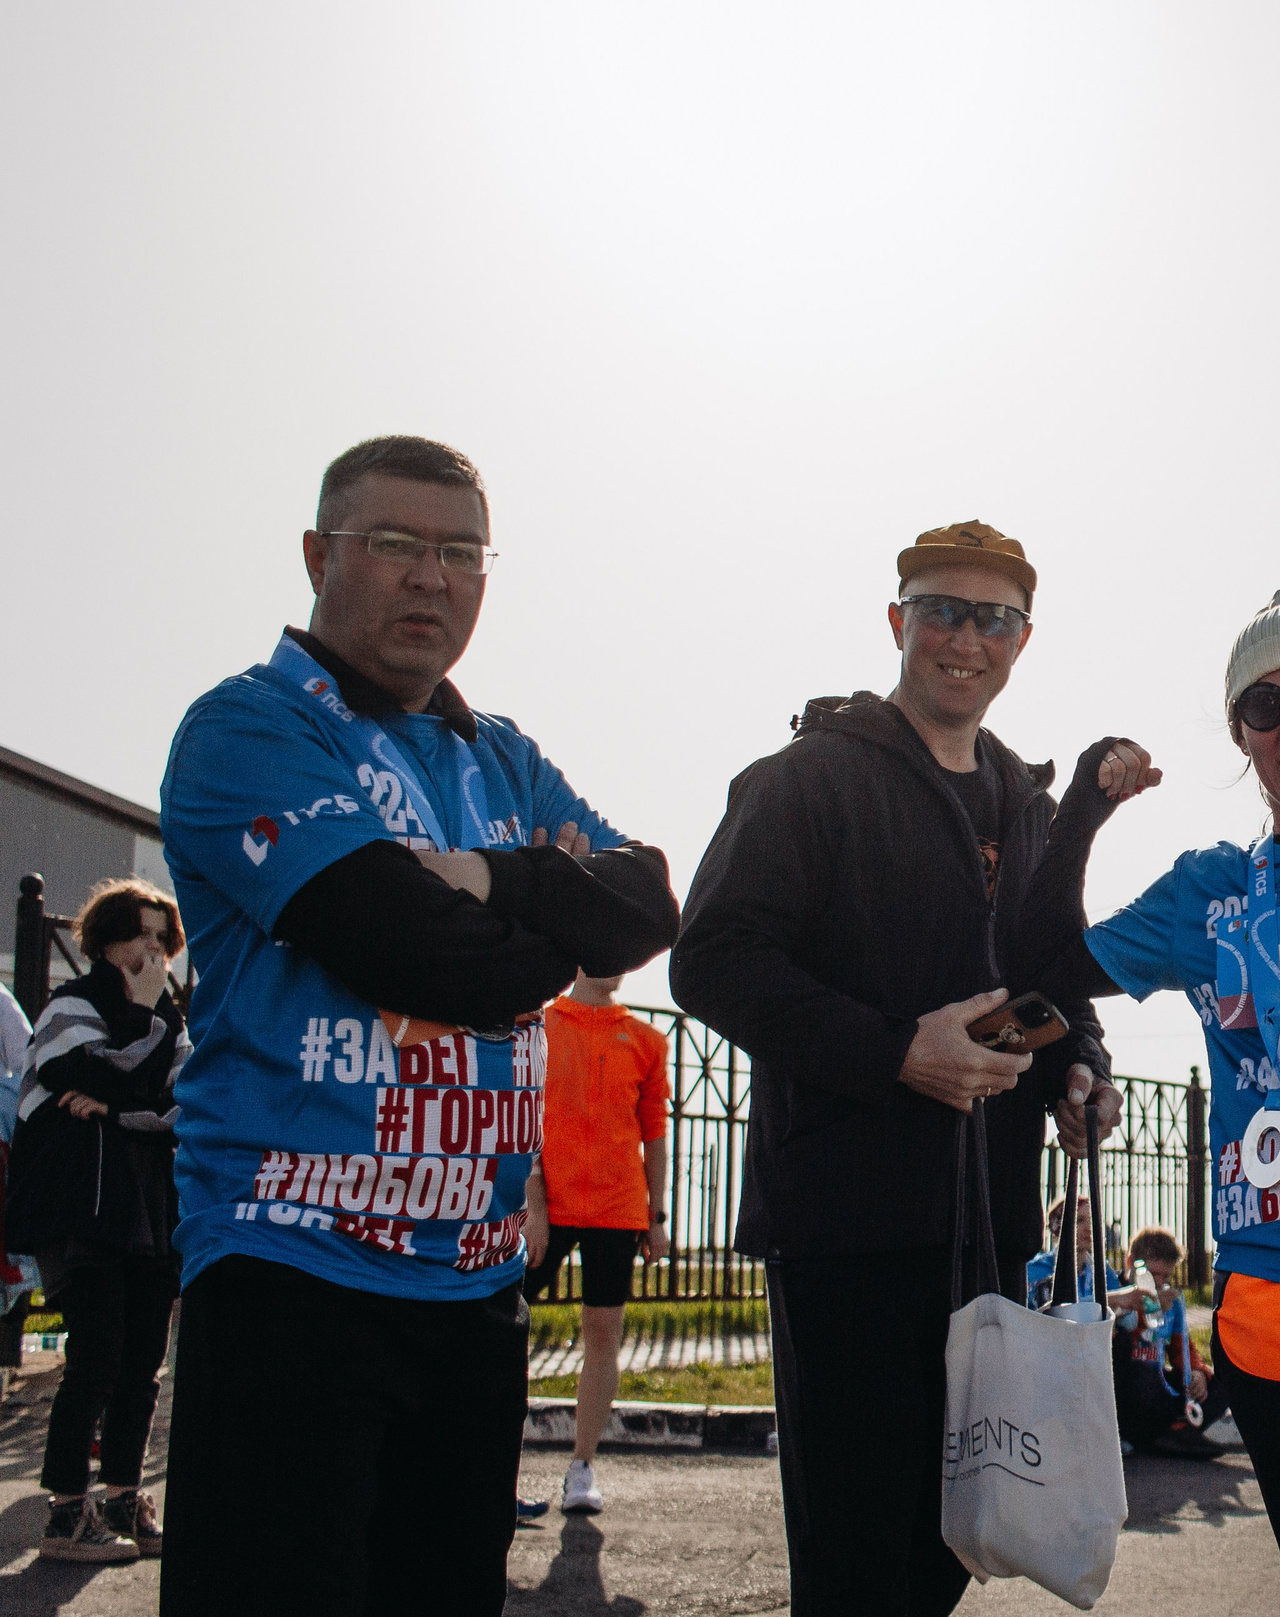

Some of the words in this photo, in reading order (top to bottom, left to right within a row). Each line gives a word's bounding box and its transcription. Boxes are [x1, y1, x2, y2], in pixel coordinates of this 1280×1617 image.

[319, 692, 356, 723] ПСБ
[1255, 870, 1267, 897] ПСБ
[299, 1017, 479, 1087] #ЗАБЕГ
[253, 1150, 499, 1221] #ЛЮБОВЬ
[945, 1416, 1042, 1467] EMENTS
